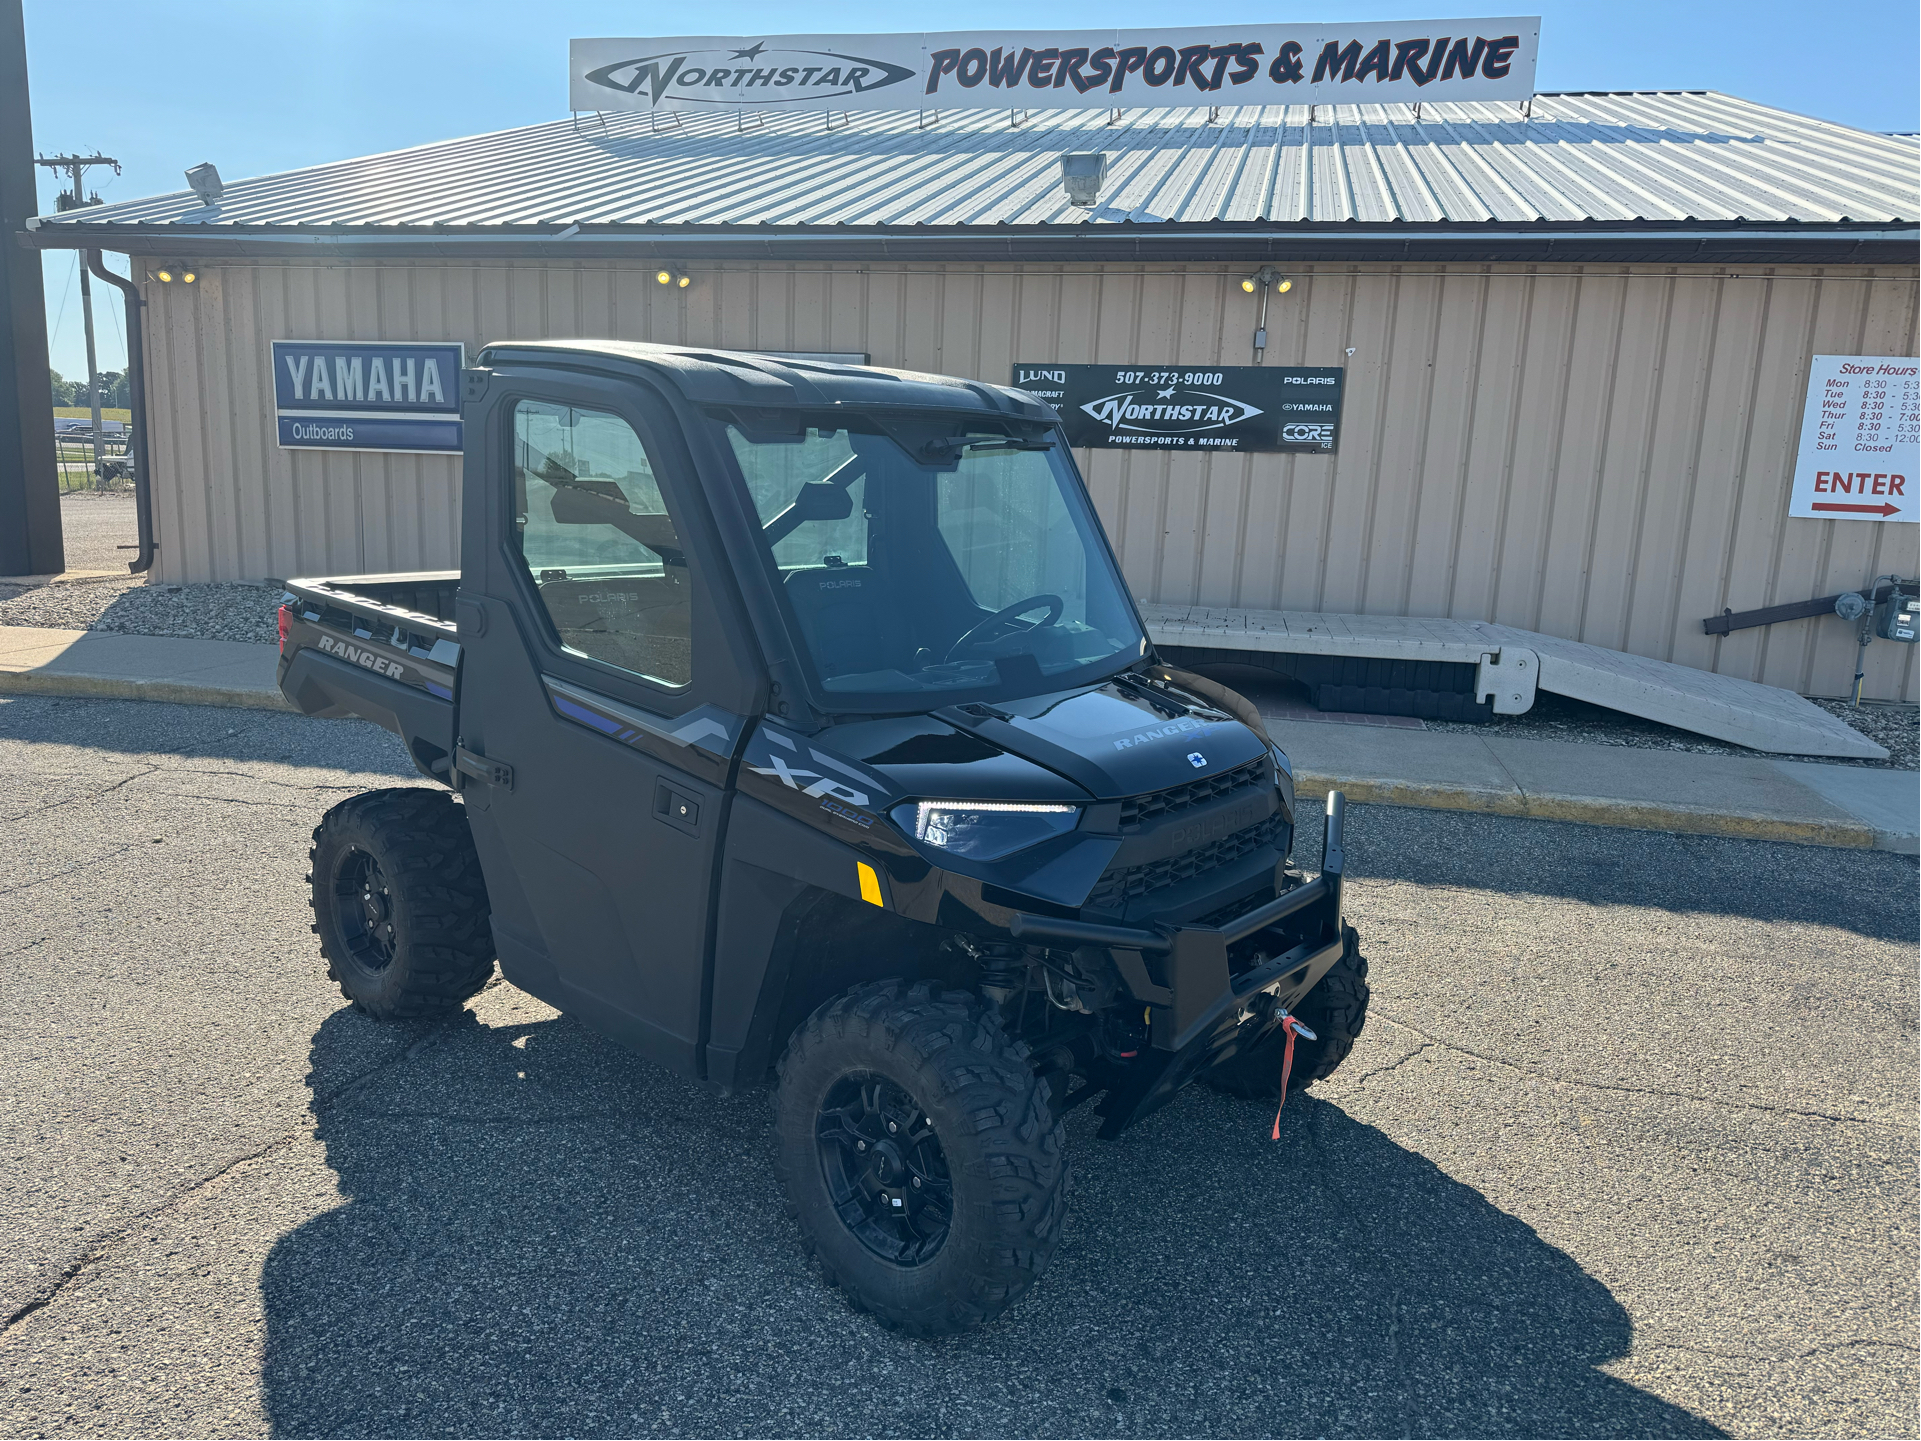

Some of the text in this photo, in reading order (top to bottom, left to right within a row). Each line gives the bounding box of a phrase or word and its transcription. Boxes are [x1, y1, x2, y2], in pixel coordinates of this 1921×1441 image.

[626, 35, 1519, 107] NORTHSTAR POWERSPORTS & MARINE
[1839, 363, 1917, 376] Store Hours
[285, 356, 444, 402] YAMAHA
[1019, 370, 1065, 384] LUND
[1115, 371, 1223, 385] 507-373-9000
[1283, 376, 1335, 384] POLARIS
[1825, 379, 1850, 388] Mon
[1863, 380, 1887, 389] 8:30
[1824, 390, 1844, 398] Tue
[1862, 391, 1886, 399] 8:30
[1902, 391, 1920, 400] 5:3
[1822, 400, 1846, 409] Wed
[1861, 401, 1884, 410] 8:30
[1099, 395, 1234, 431] NORTHSTAR
[1821, 410, 1846, 420] Thur
[1859, 412, 1883, 421] 8:30
[292, 423, 354, 440] Outboards
[1282, 425, 1334, 441] CORE
[1819, 421, 1835, 430] Fri
[1857, 422, 1881, 431] 8:30
[1897, 423, 1920, 433] 5:30
[1108, 435, 1239, 446] POWERSPORTS & MARINE
[1817, 431, 1836, 440] Sat
[1856, 433, 1879, 442] 8:30
[1816, 442, 1893, 453] Sun Closed
[1814, 471, 1906, 496] ENTER
[818, 580, 862, 590] POLARIS
[578, 592, 639, 604] POLARIS
[318, 635, 404, 679] RANGER
[1112, 718, 1208, 751] RANGER
[1180, 725, 1221, 743] XP
[747, 754, 869, 806] XP
[821, 799, 874, 826] 1000
[1171, 804, 1254, 849] POLARIS
